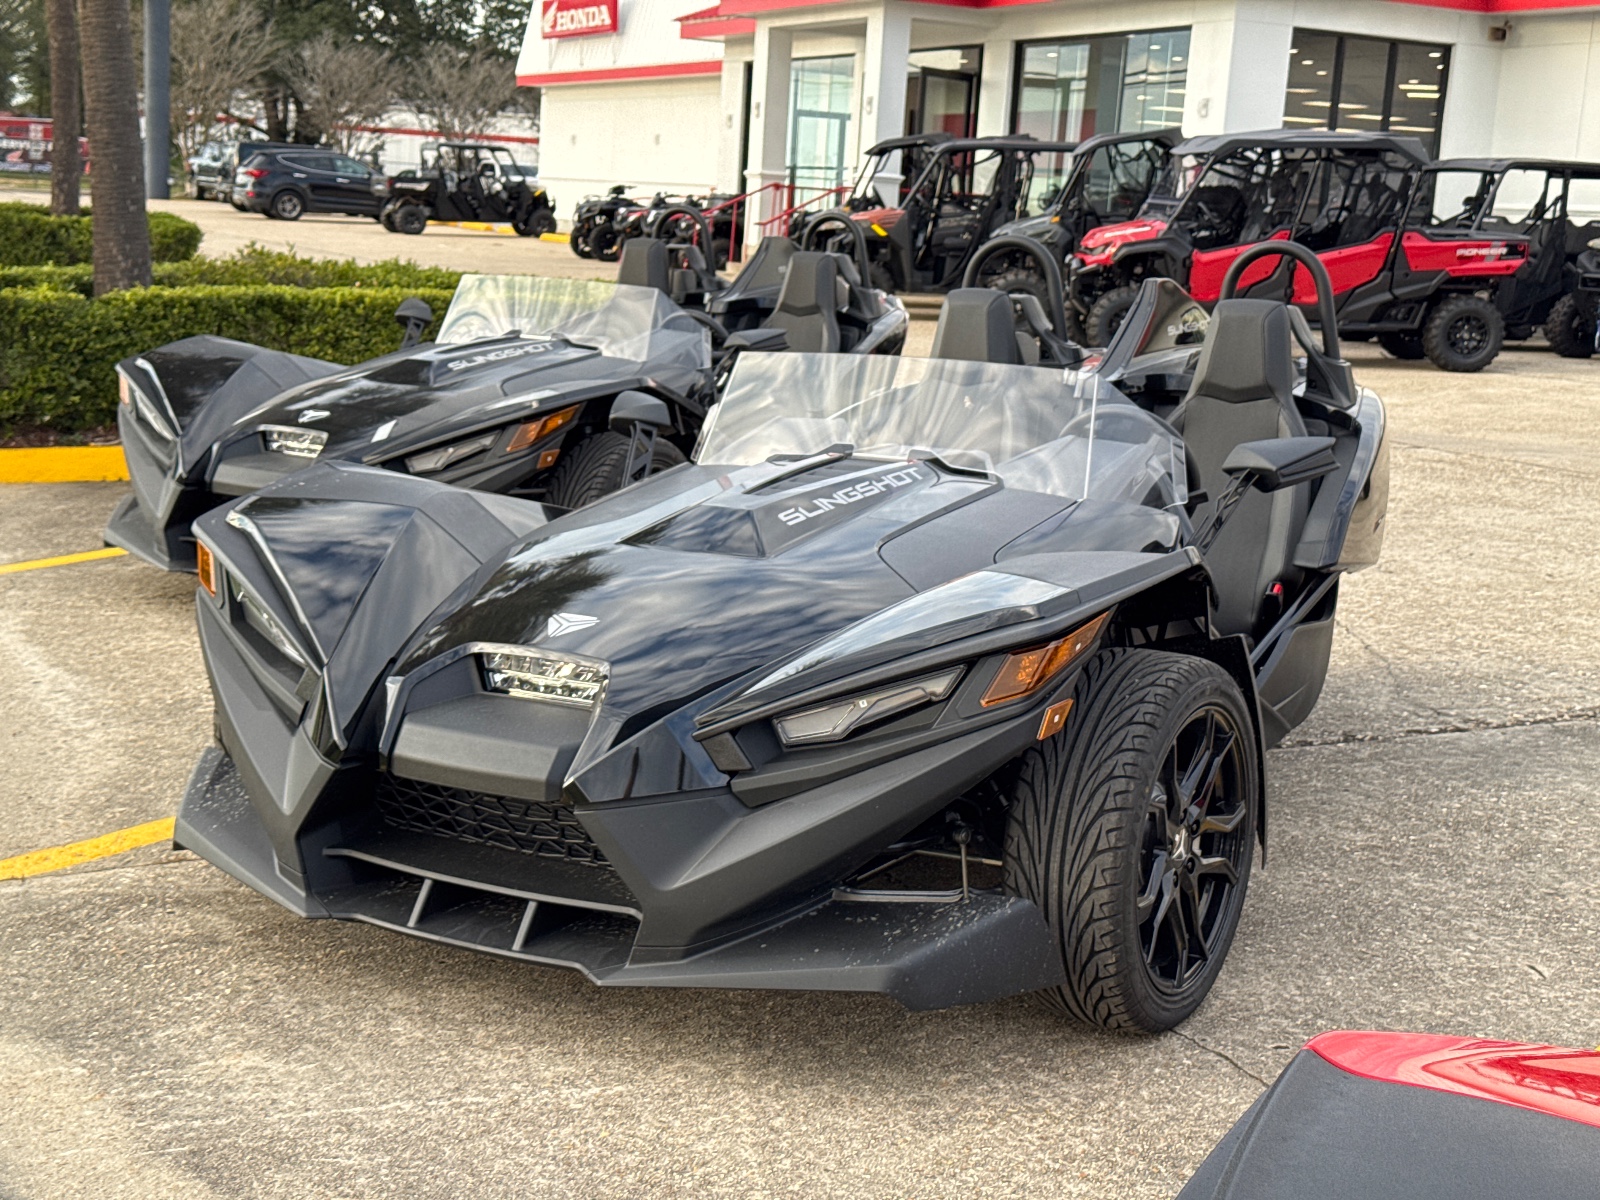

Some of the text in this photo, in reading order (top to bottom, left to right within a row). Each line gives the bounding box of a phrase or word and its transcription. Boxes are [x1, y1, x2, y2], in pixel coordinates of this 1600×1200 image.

[556, 4, 611, 31] HONDA
[1456, 247, 1508, 257] PIONEER
[447, 342, 554, 371] SLINGSHOT
[778, 467, 923, 526] SLINGSHOT
